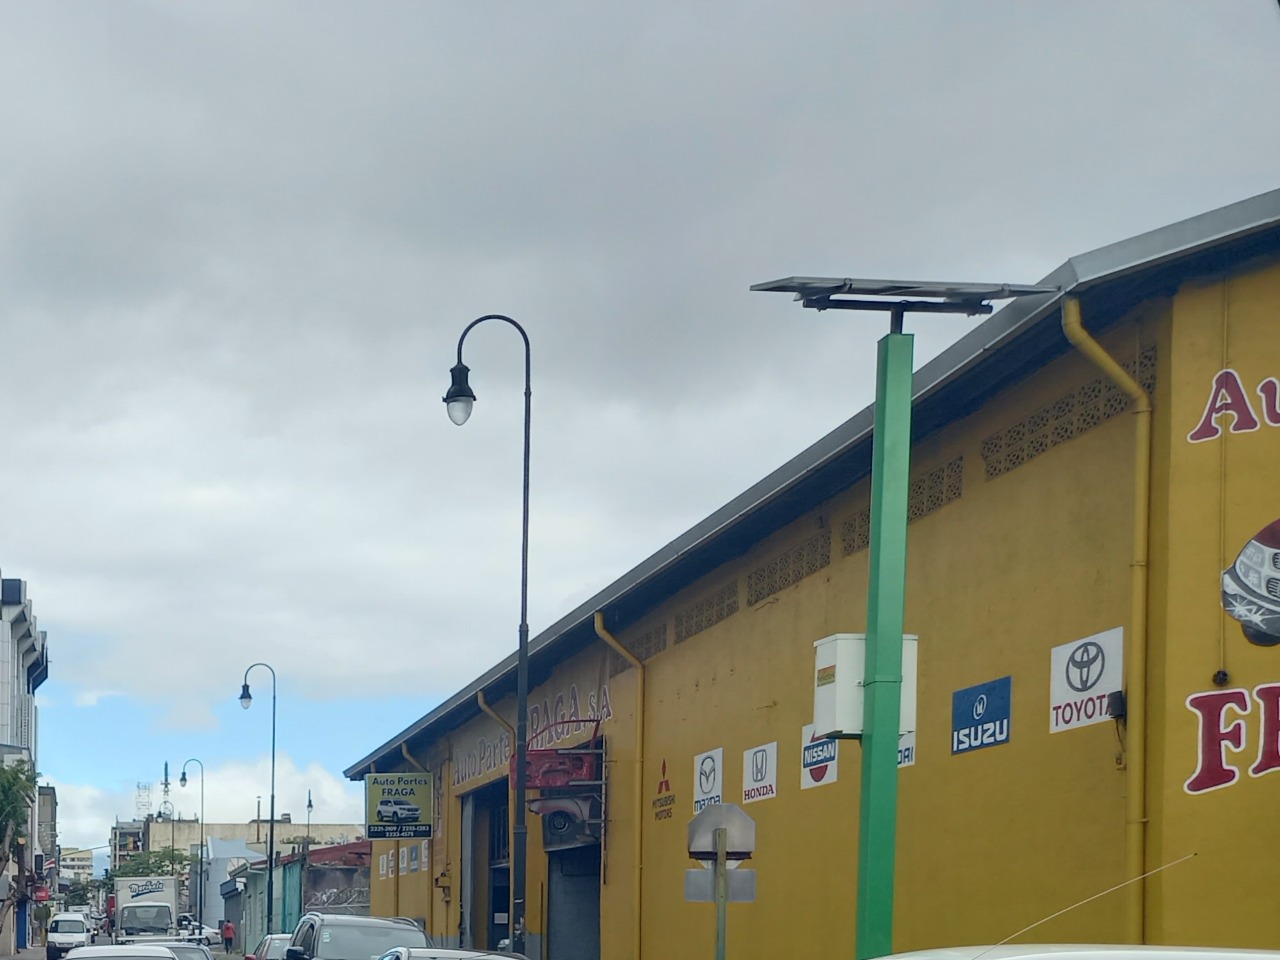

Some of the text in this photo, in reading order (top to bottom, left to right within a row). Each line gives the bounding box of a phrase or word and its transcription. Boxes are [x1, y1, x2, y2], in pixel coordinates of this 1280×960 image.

[952, 718, 1009, 751] ISUZU
[804, 742, 836, 765] NISSAN
[372, 776, 428, 786] Auto Partes
[381, 787, 417, 797] FRAGA
[743, 784, 775, 801] HONDA
[651, 794, 676, 810] MITSUBISHI
[654, 807, 673, 822] MOTORS
